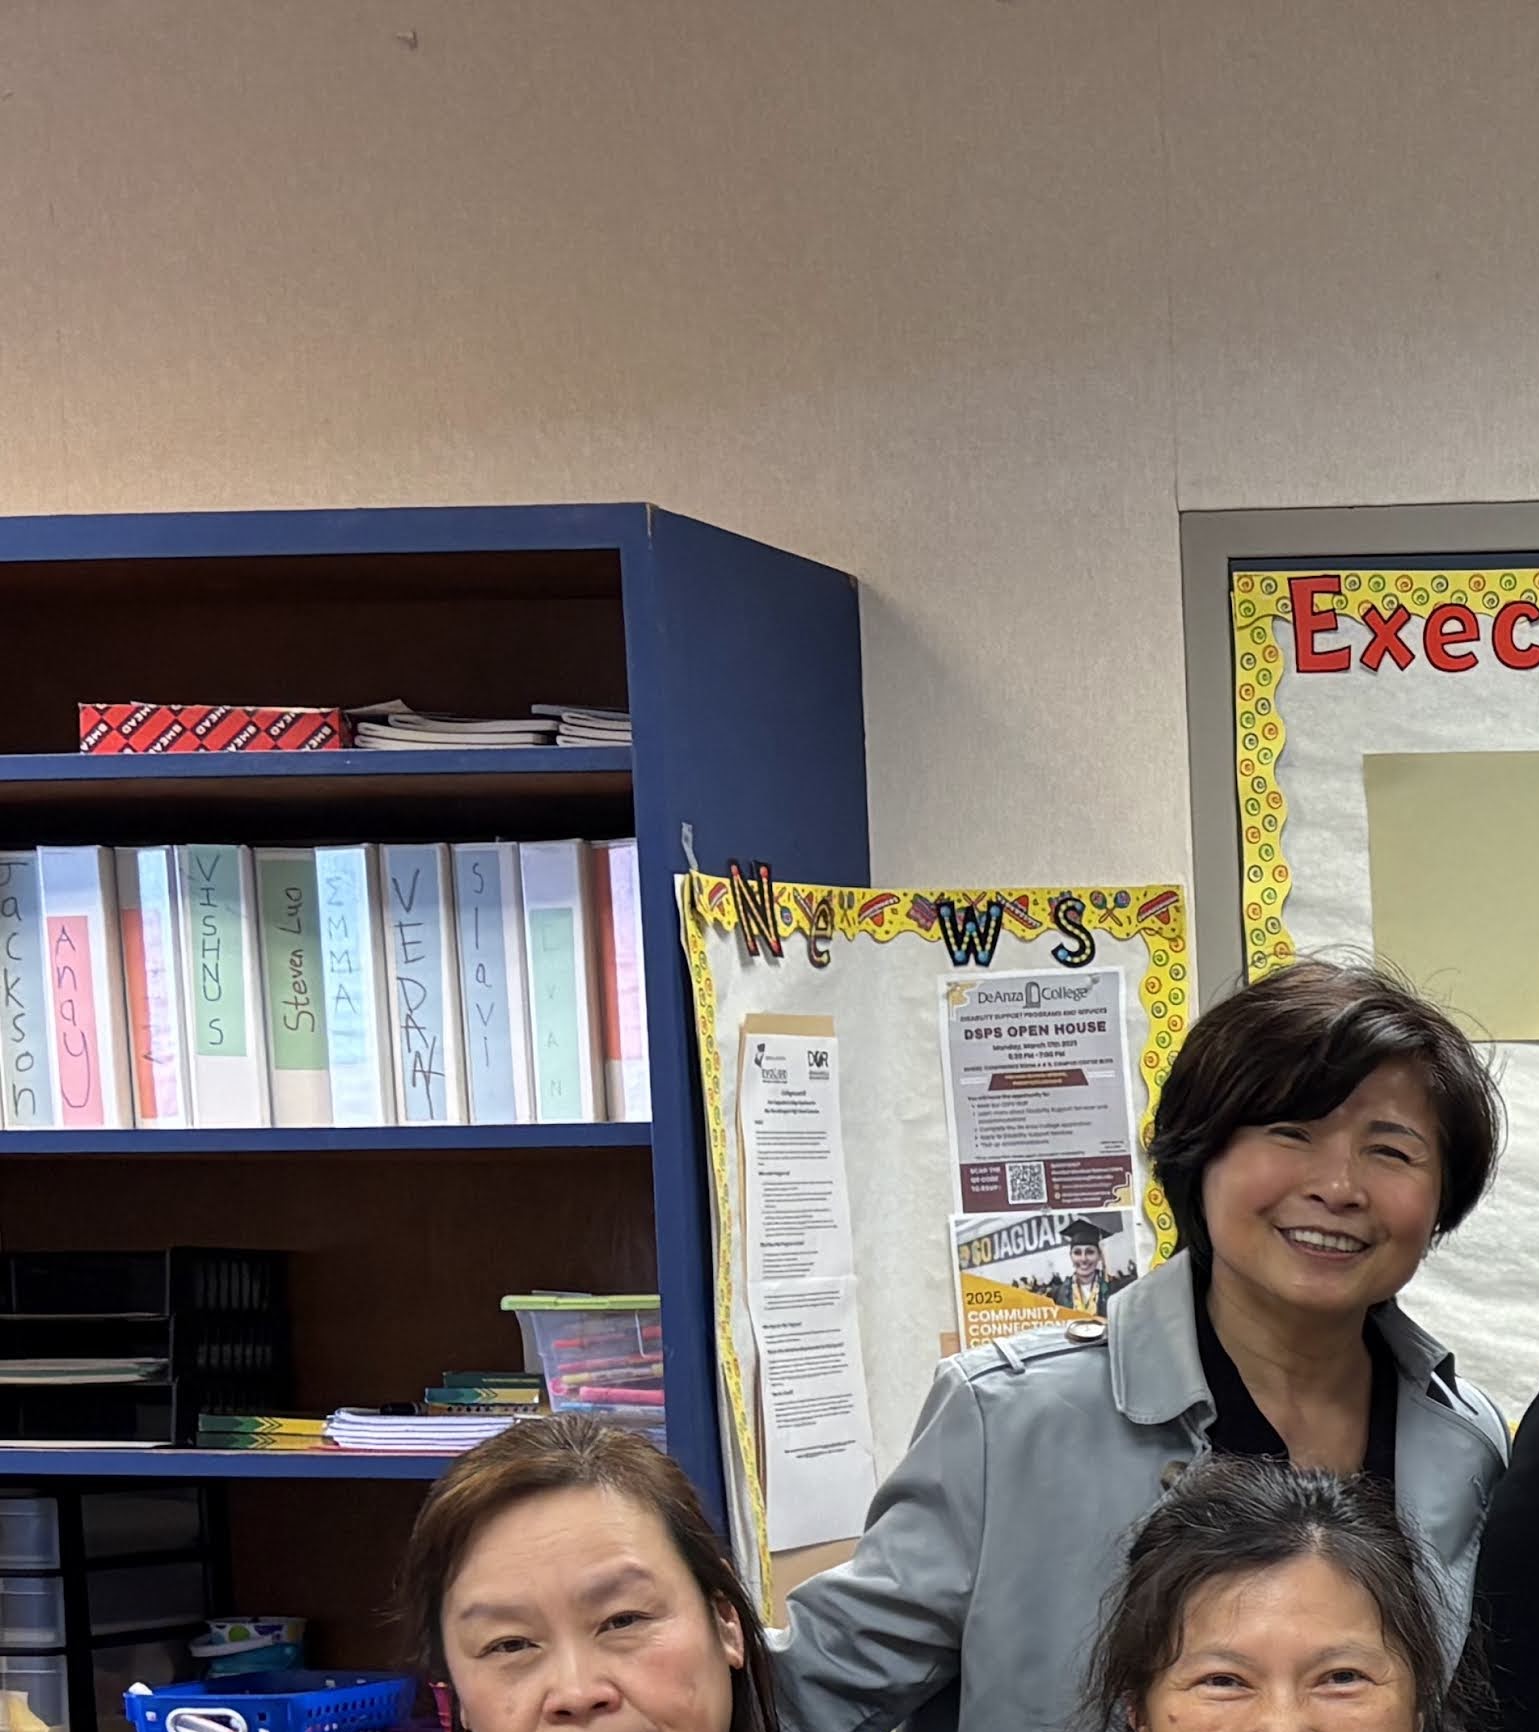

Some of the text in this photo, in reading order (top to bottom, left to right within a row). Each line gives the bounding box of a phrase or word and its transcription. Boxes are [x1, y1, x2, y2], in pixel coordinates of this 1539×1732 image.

[279, 886, 316, 1033] Steven Luo
[1042, 986, 1088, 1000] College
[964, 1021, 1106, 1040] DSPS OPEN HOUSE
[993, 1214, 1082, 1260] JAGUAR
[966, 1290, 1003, 1305] 2025
[968, 1306, 1060, 1323] COMMUNITY
